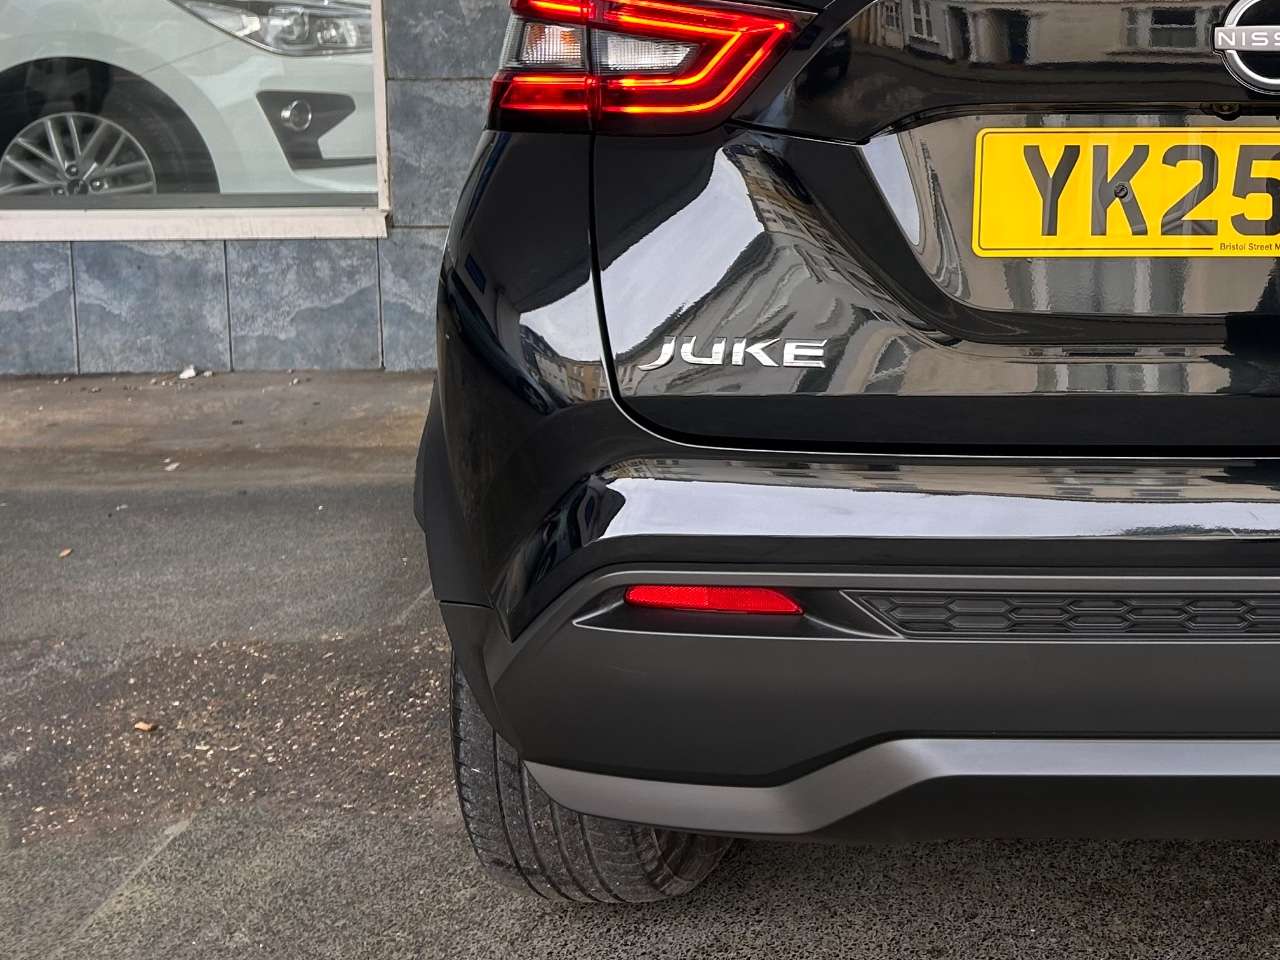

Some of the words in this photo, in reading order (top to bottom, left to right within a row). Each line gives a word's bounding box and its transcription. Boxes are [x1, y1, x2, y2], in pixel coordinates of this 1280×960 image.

[1219, 242, 1246, 251] Bristol
[1248, 243, 1272, 251] Street
[637, 335, 828, 371] JUKE
